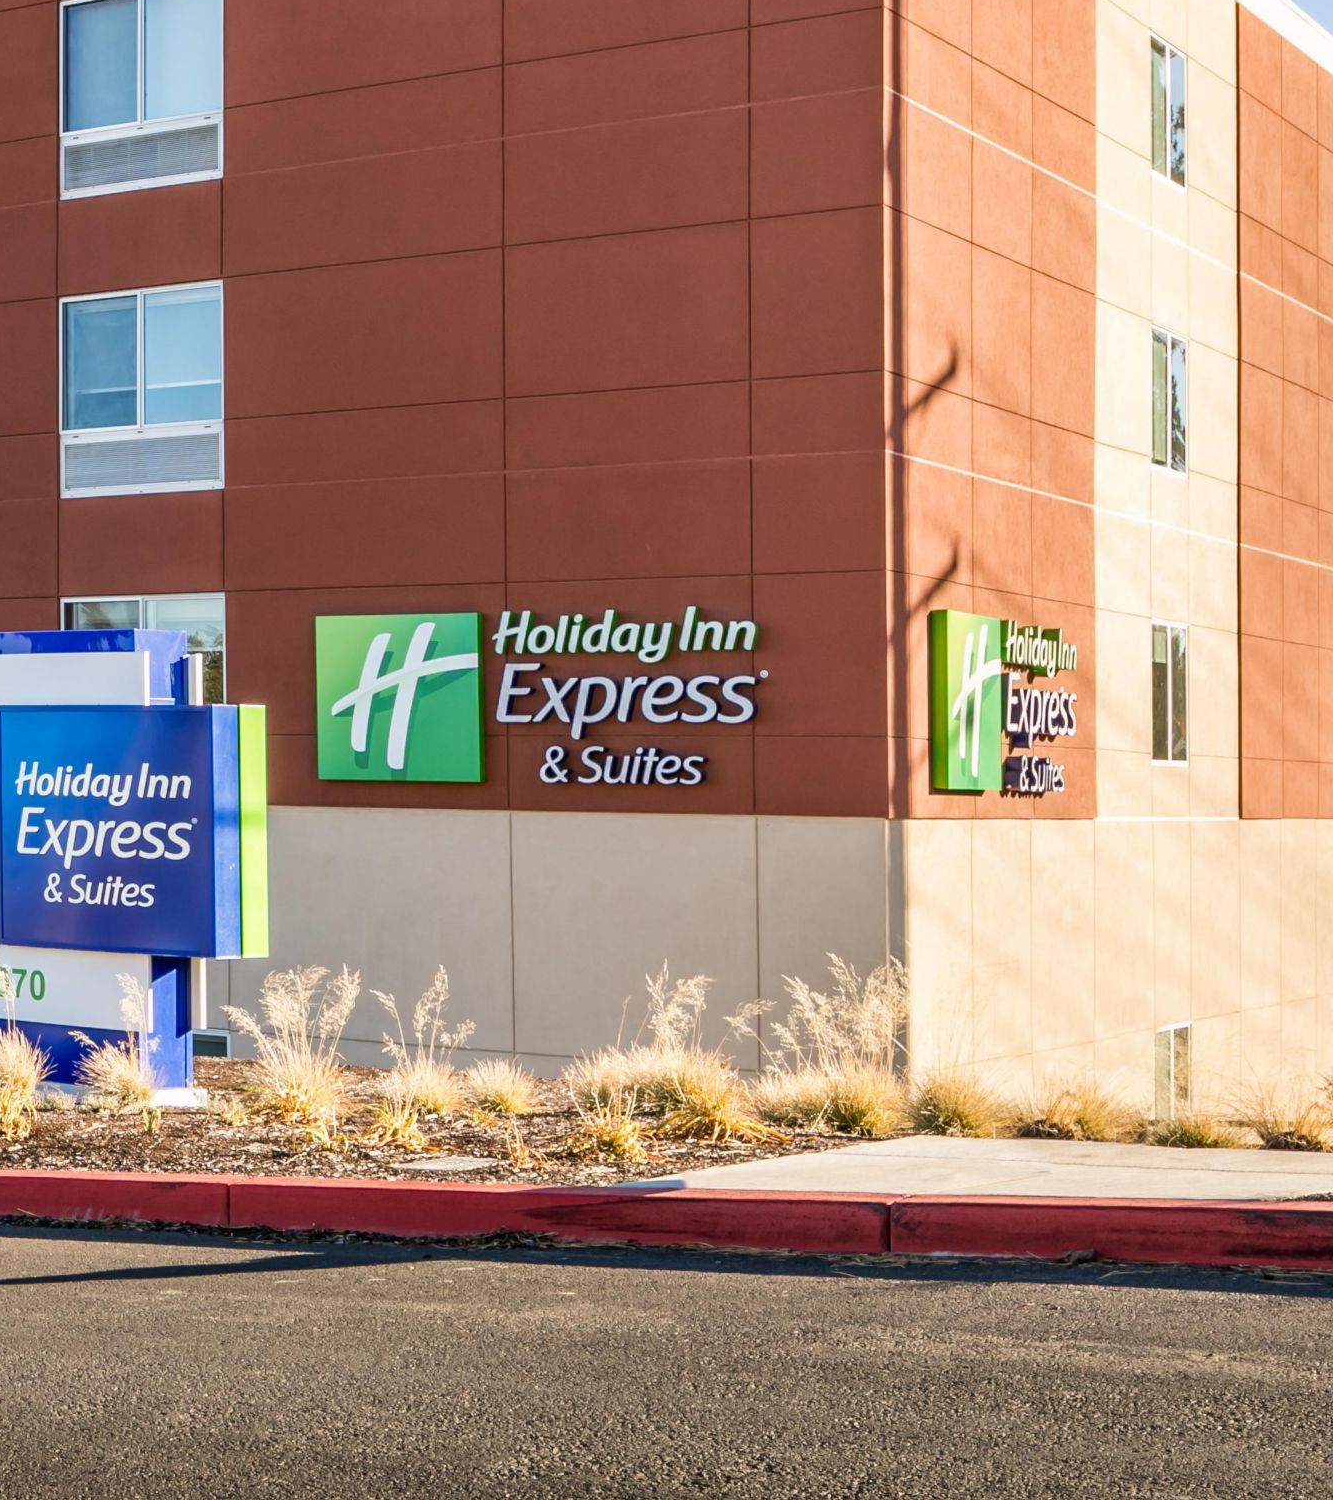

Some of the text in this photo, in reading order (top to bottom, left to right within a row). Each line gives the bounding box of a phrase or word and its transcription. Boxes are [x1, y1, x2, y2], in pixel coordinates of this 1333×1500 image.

[492, 606, 757, 663] Holiday Inn
[1006, 620, 1077, 678] Holiday Inn
[1006, 672, 1078, 748] Express
[15, 761, 192, 806] Holiday Inn
[539, 745, 704, 785] & Suites
[1019, 755, 1065, 792] & Suites
[43, 873, 155, 907] & Suites
